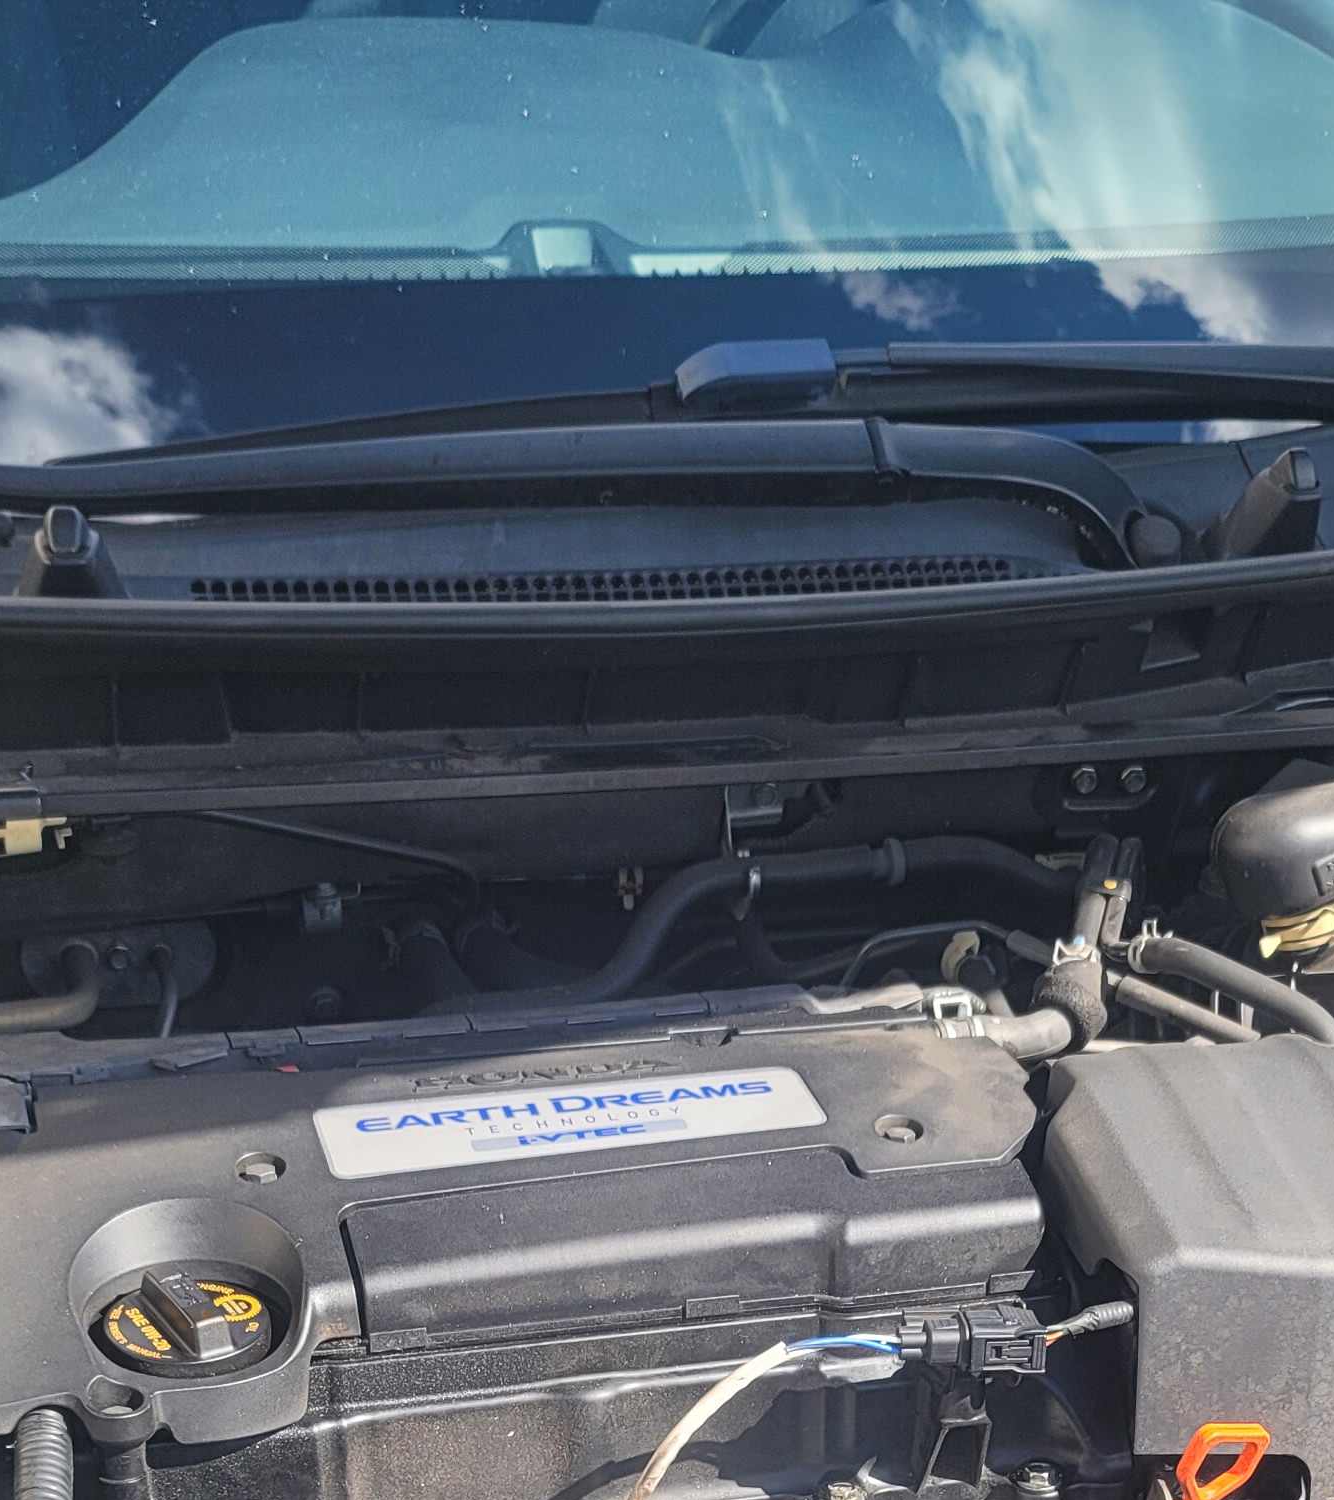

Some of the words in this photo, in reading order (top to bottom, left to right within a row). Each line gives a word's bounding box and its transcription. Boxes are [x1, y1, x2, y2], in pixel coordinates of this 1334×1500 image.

[355, 1100, 539, 1133] EARTH
[549, 1080, 773, 1115] DREAMS
[466, 1105, 683, 1137] TECHNOLOGY
[518, 1124, 646, 1147] i-VTEC
[125, 1308, 150, 1327] SAE
[141, 1325, 172, 1351] 0W-20
